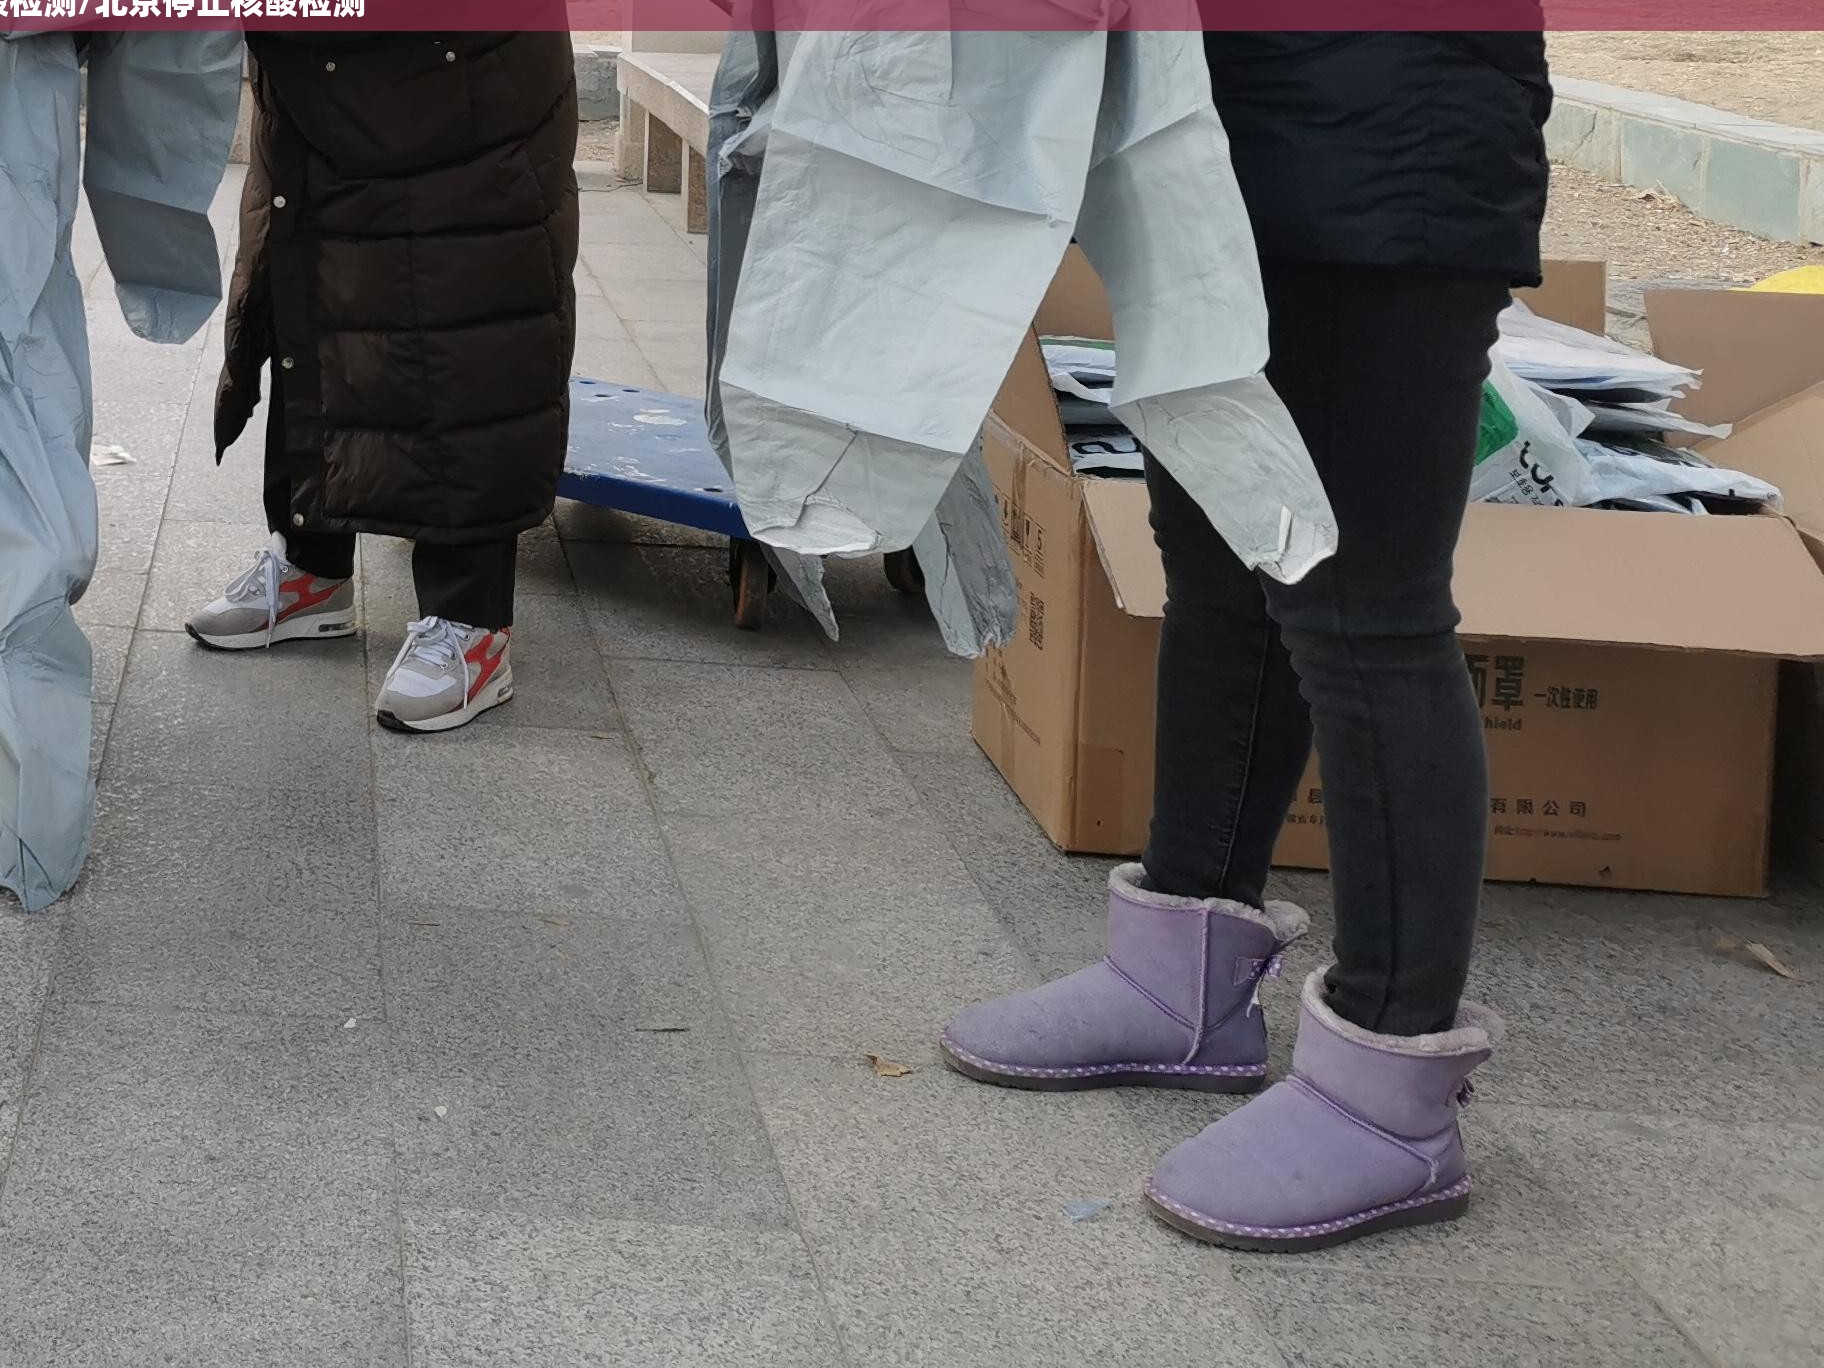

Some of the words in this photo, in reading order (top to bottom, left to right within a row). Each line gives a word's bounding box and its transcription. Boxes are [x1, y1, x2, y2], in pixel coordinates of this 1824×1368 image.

[1533, 685, 1600, 710] 一次性使用
[1482, 716, 1523, 732] hield
[1490, 797, 1587, 818] 有限公司
